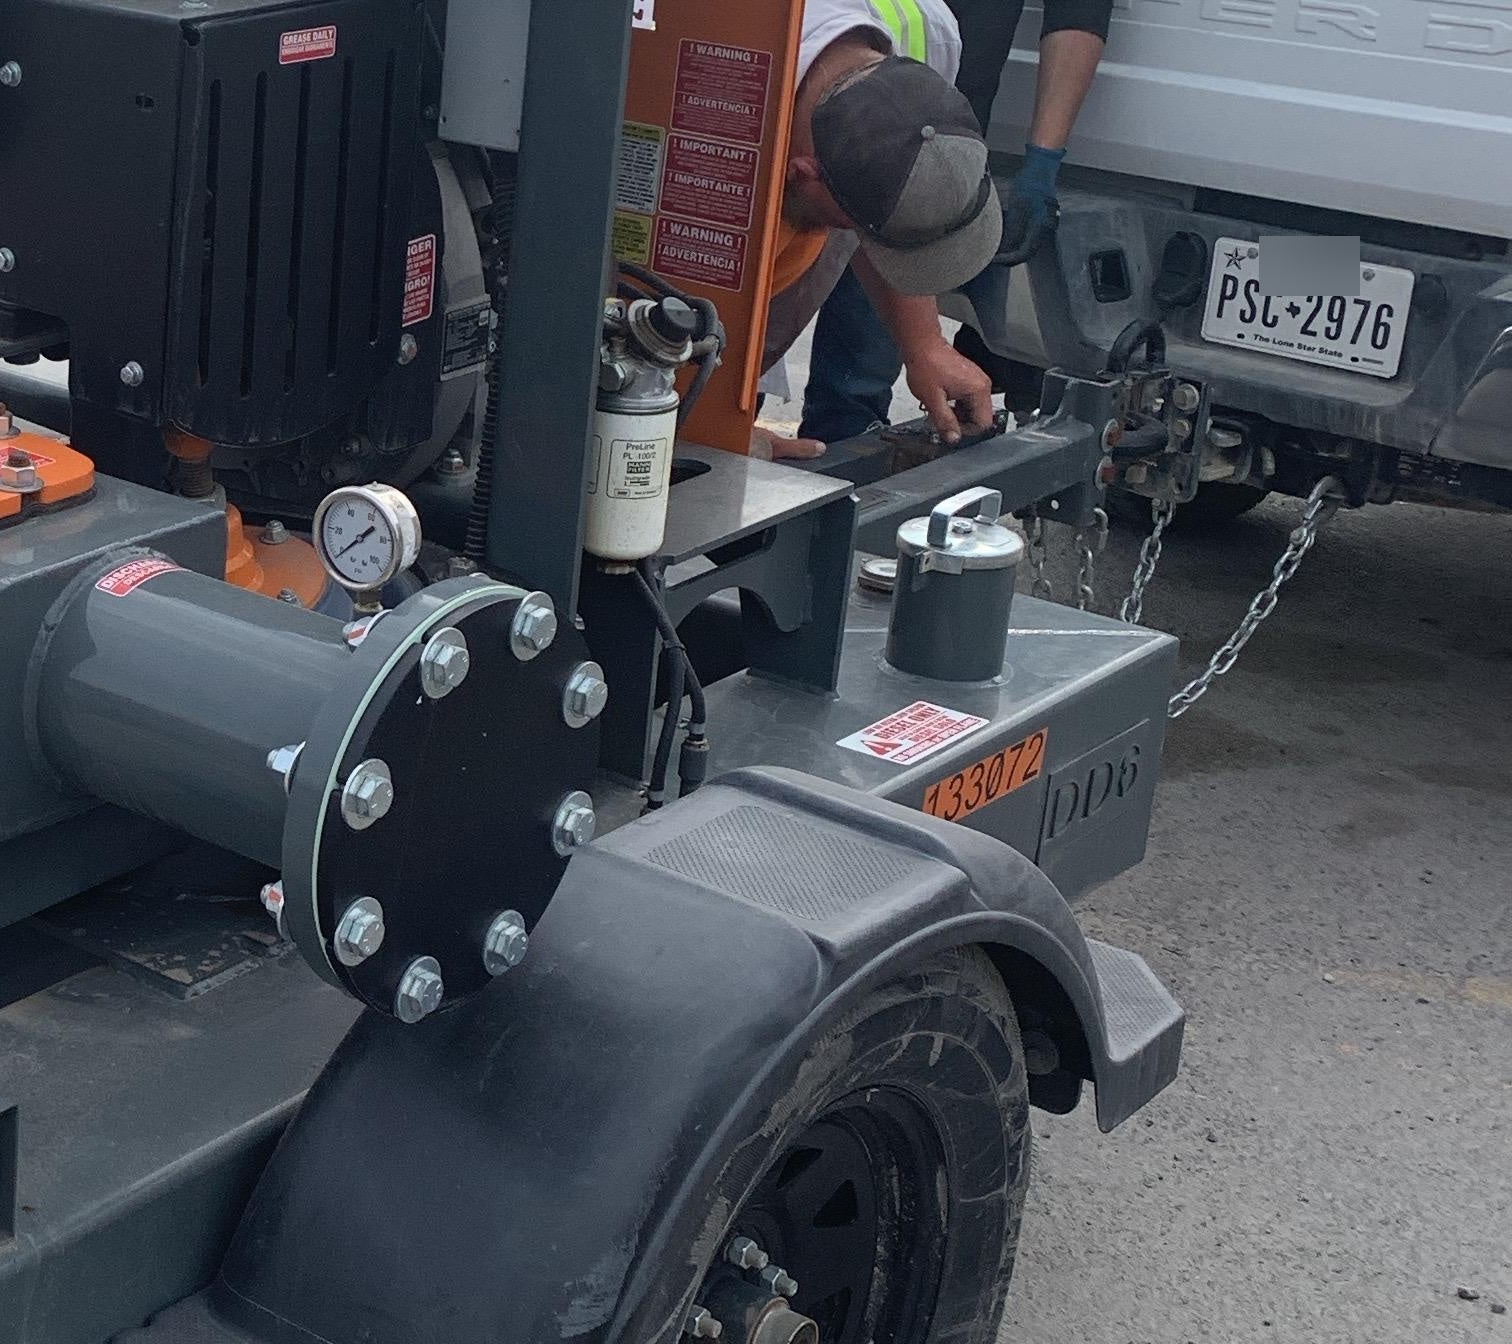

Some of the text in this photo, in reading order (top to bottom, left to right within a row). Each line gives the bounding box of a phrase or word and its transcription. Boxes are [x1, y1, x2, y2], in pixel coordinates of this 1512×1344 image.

[283, 33, 312, 46] GREASE
[696, 43, 751, 62] WARNING
[687, 95, 750, 115] ADVERTENCIA
[679, 139, 747, 161] IMPORTANT
[674, 173, 744, 196] IMPORTANTE
[669, 222, 734, 247] WARNING
[662, 245, 735, 271] ADVERTENCIA
[1216, 274, 1394, 350] PSC 2976
[1253, 333, 1343, 358] The Lone Star State
[626, 442, 656, 451] PreLine
[927, 732, 1045, 821] 133072
[1046, 745, 1140, 840] DD6
